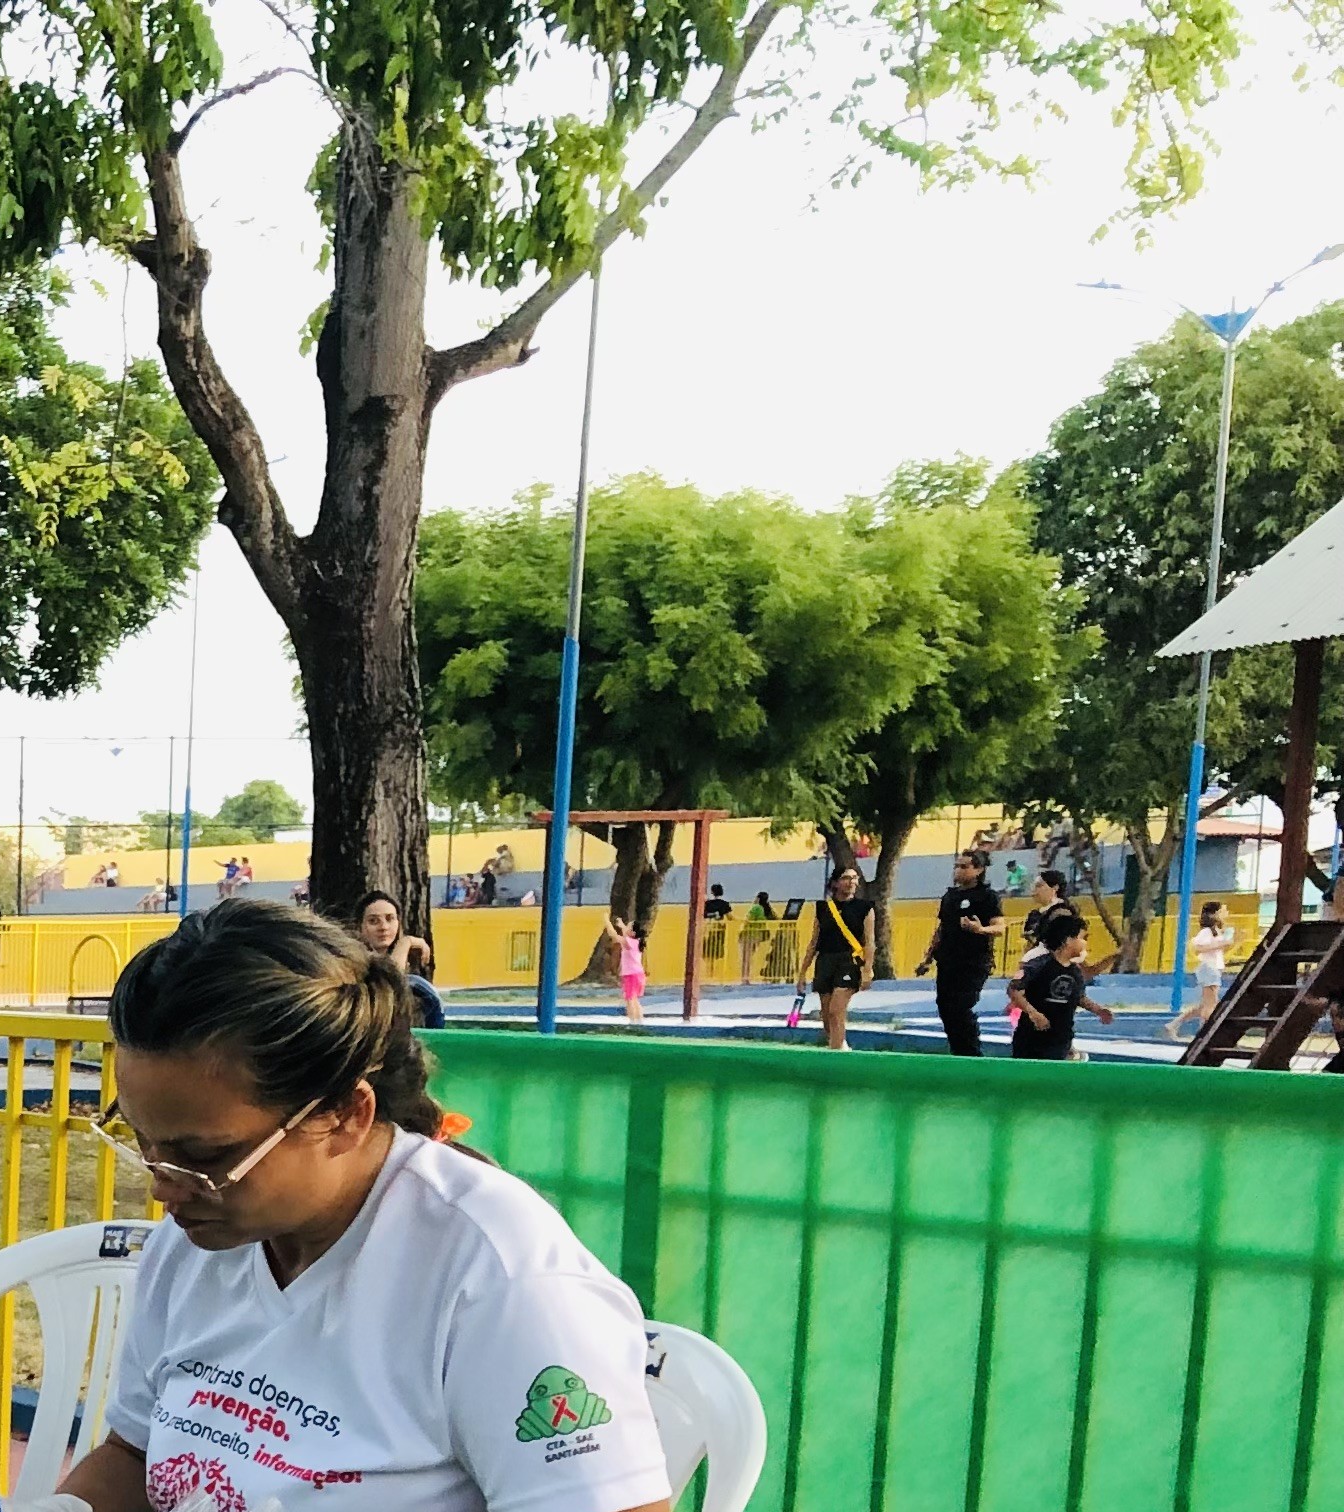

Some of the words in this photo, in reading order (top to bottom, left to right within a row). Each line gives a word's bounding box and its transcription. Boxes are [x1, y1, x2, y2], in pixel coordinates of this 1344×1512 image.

[248, 1374, 341, 1438] doenças,
[544, 1444, 600, 1463] SANTARÉM
[546, 1440, 567, 1451] CTA
